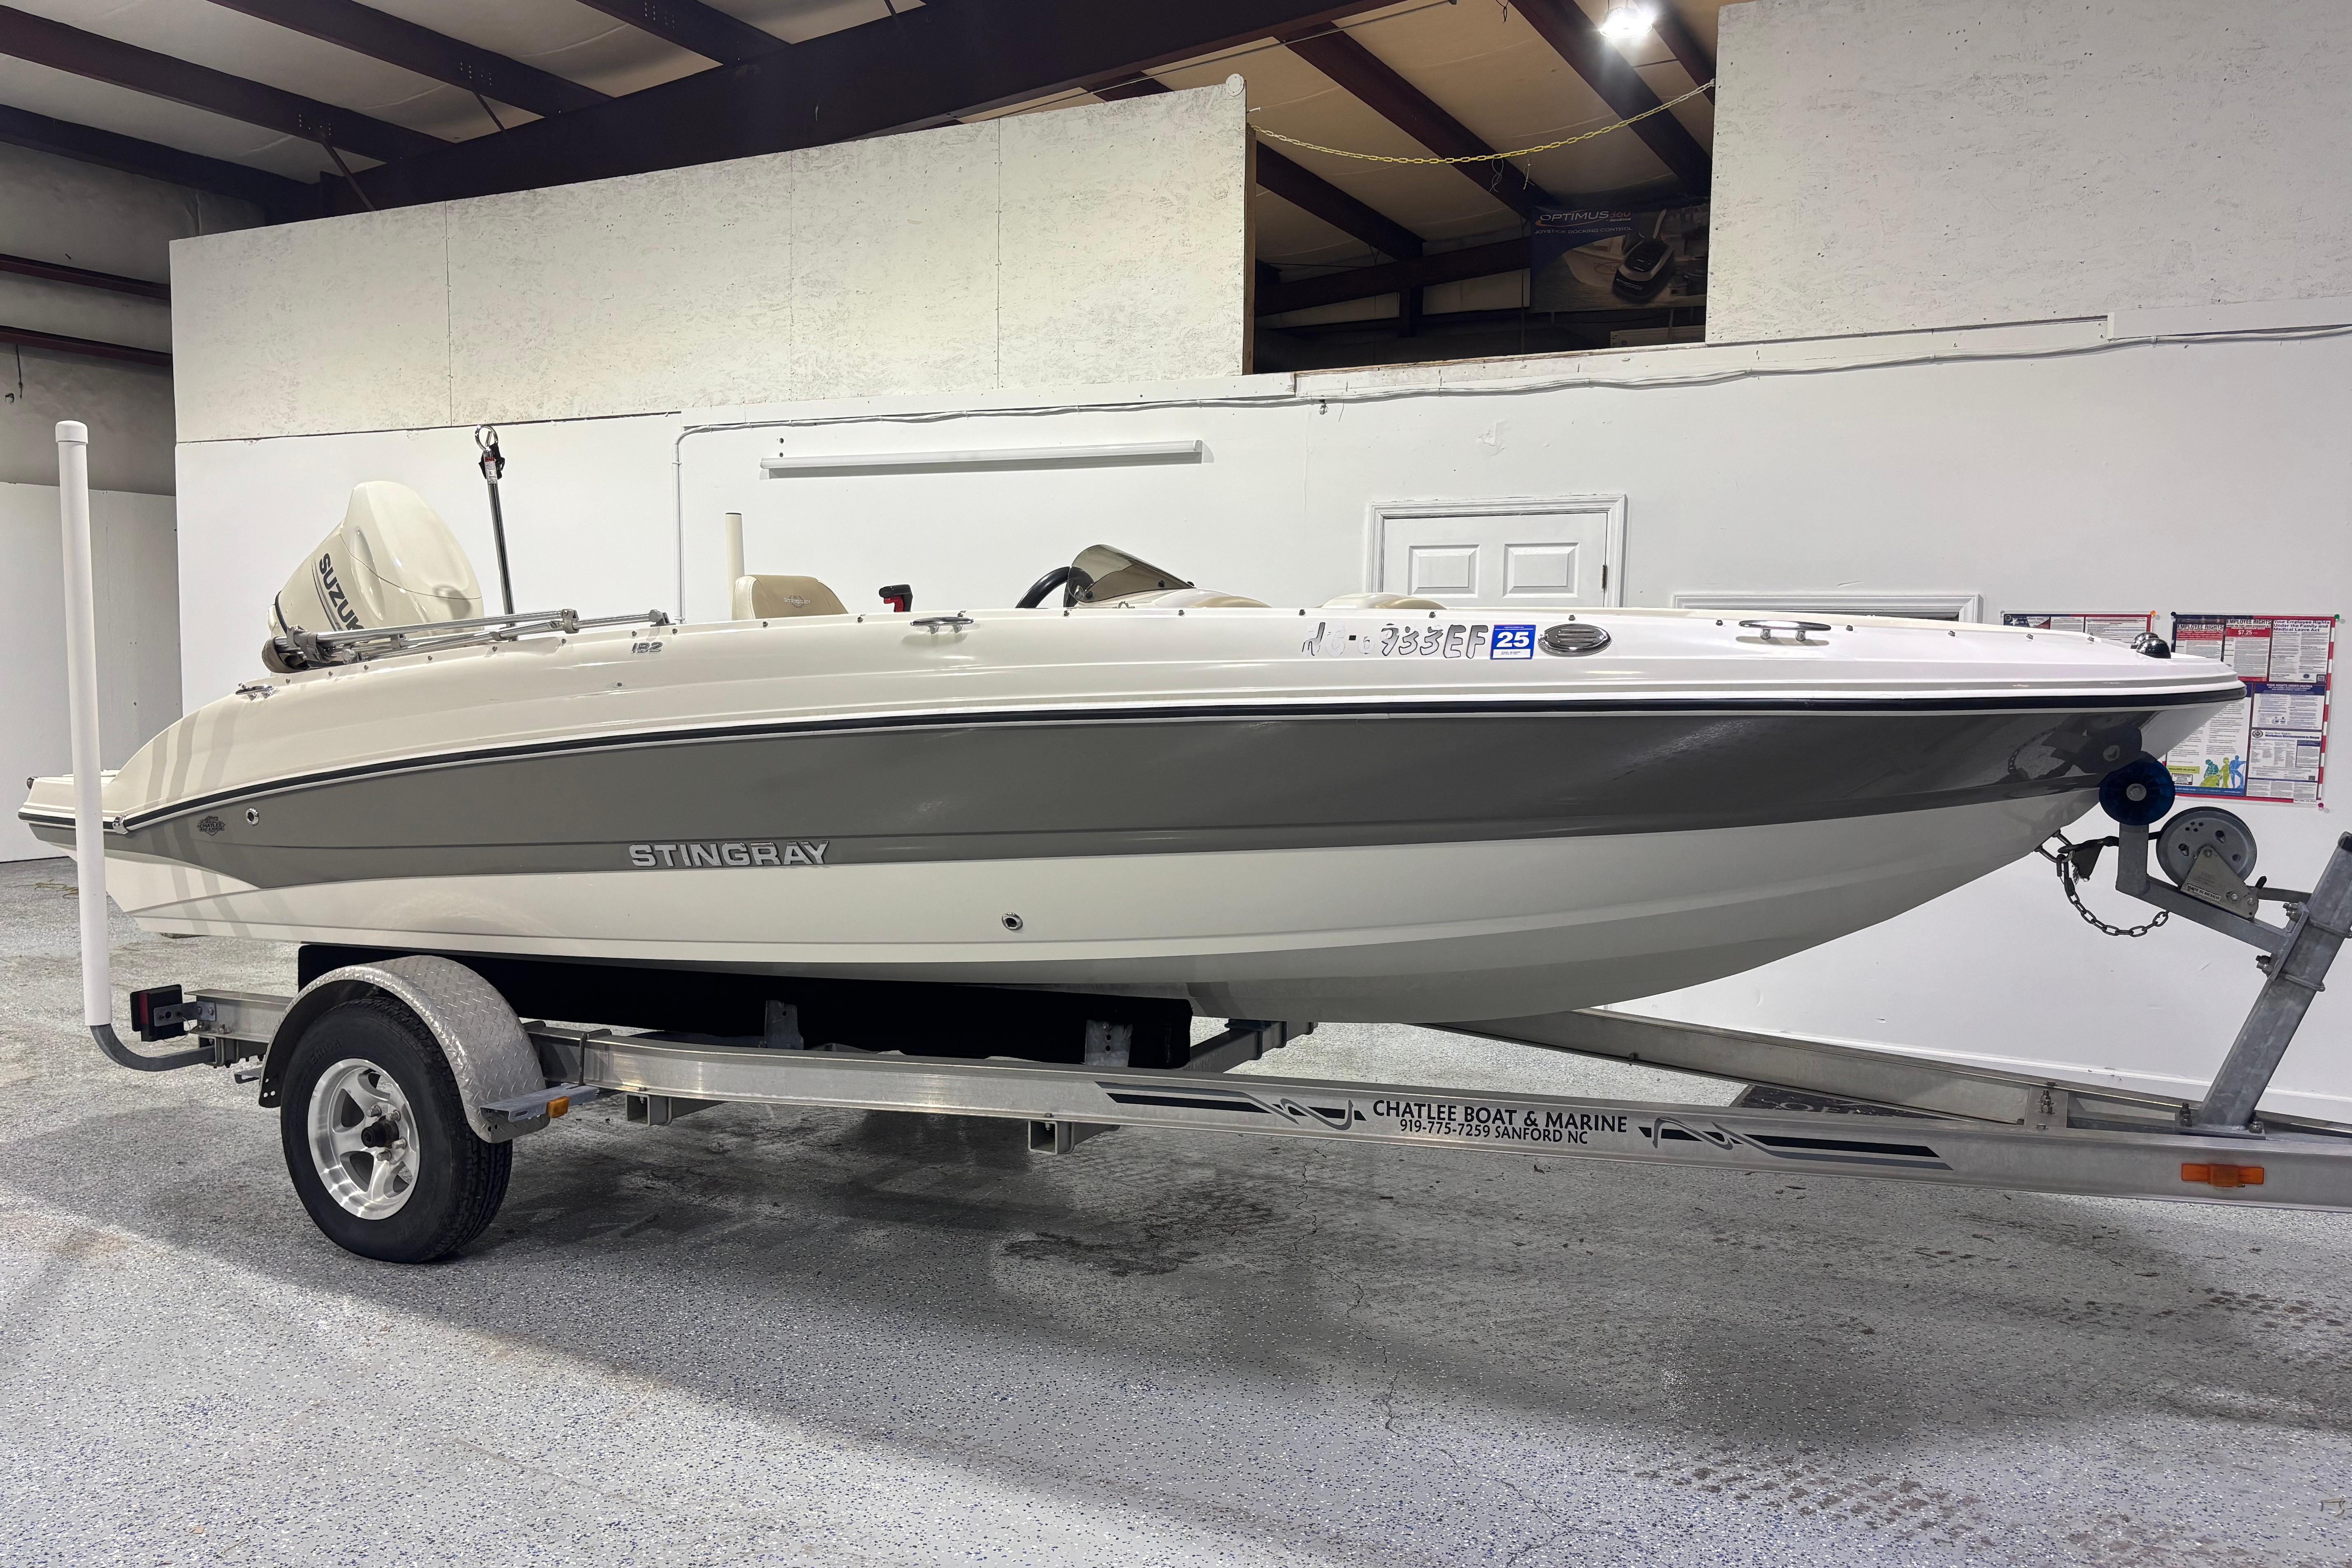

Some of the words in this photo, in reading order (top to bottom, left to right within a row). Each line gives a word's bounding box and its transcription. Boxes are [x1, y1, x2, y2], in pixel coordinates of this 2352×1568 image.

[320, 553, 365, 630] SUZUK
[631, 642, 663, 653] 182
[1496, 631, 1529, 647] 25
[629, 840, 829, 867] STINGRAY
[1373, 1100, 1457, 1121] CHATLEE
[1464, 1106, 1517, 1125] BOAT
[1524, 1111, 1538, 1127] &
[1545, 1111, 1627, 1133] MARINE
[1400, 1118, 1490, 1138] 919-775-7259
[1495, 1125, 1563, 1142] SANFORD
[1568, 1130, 1588, 1144] NC
